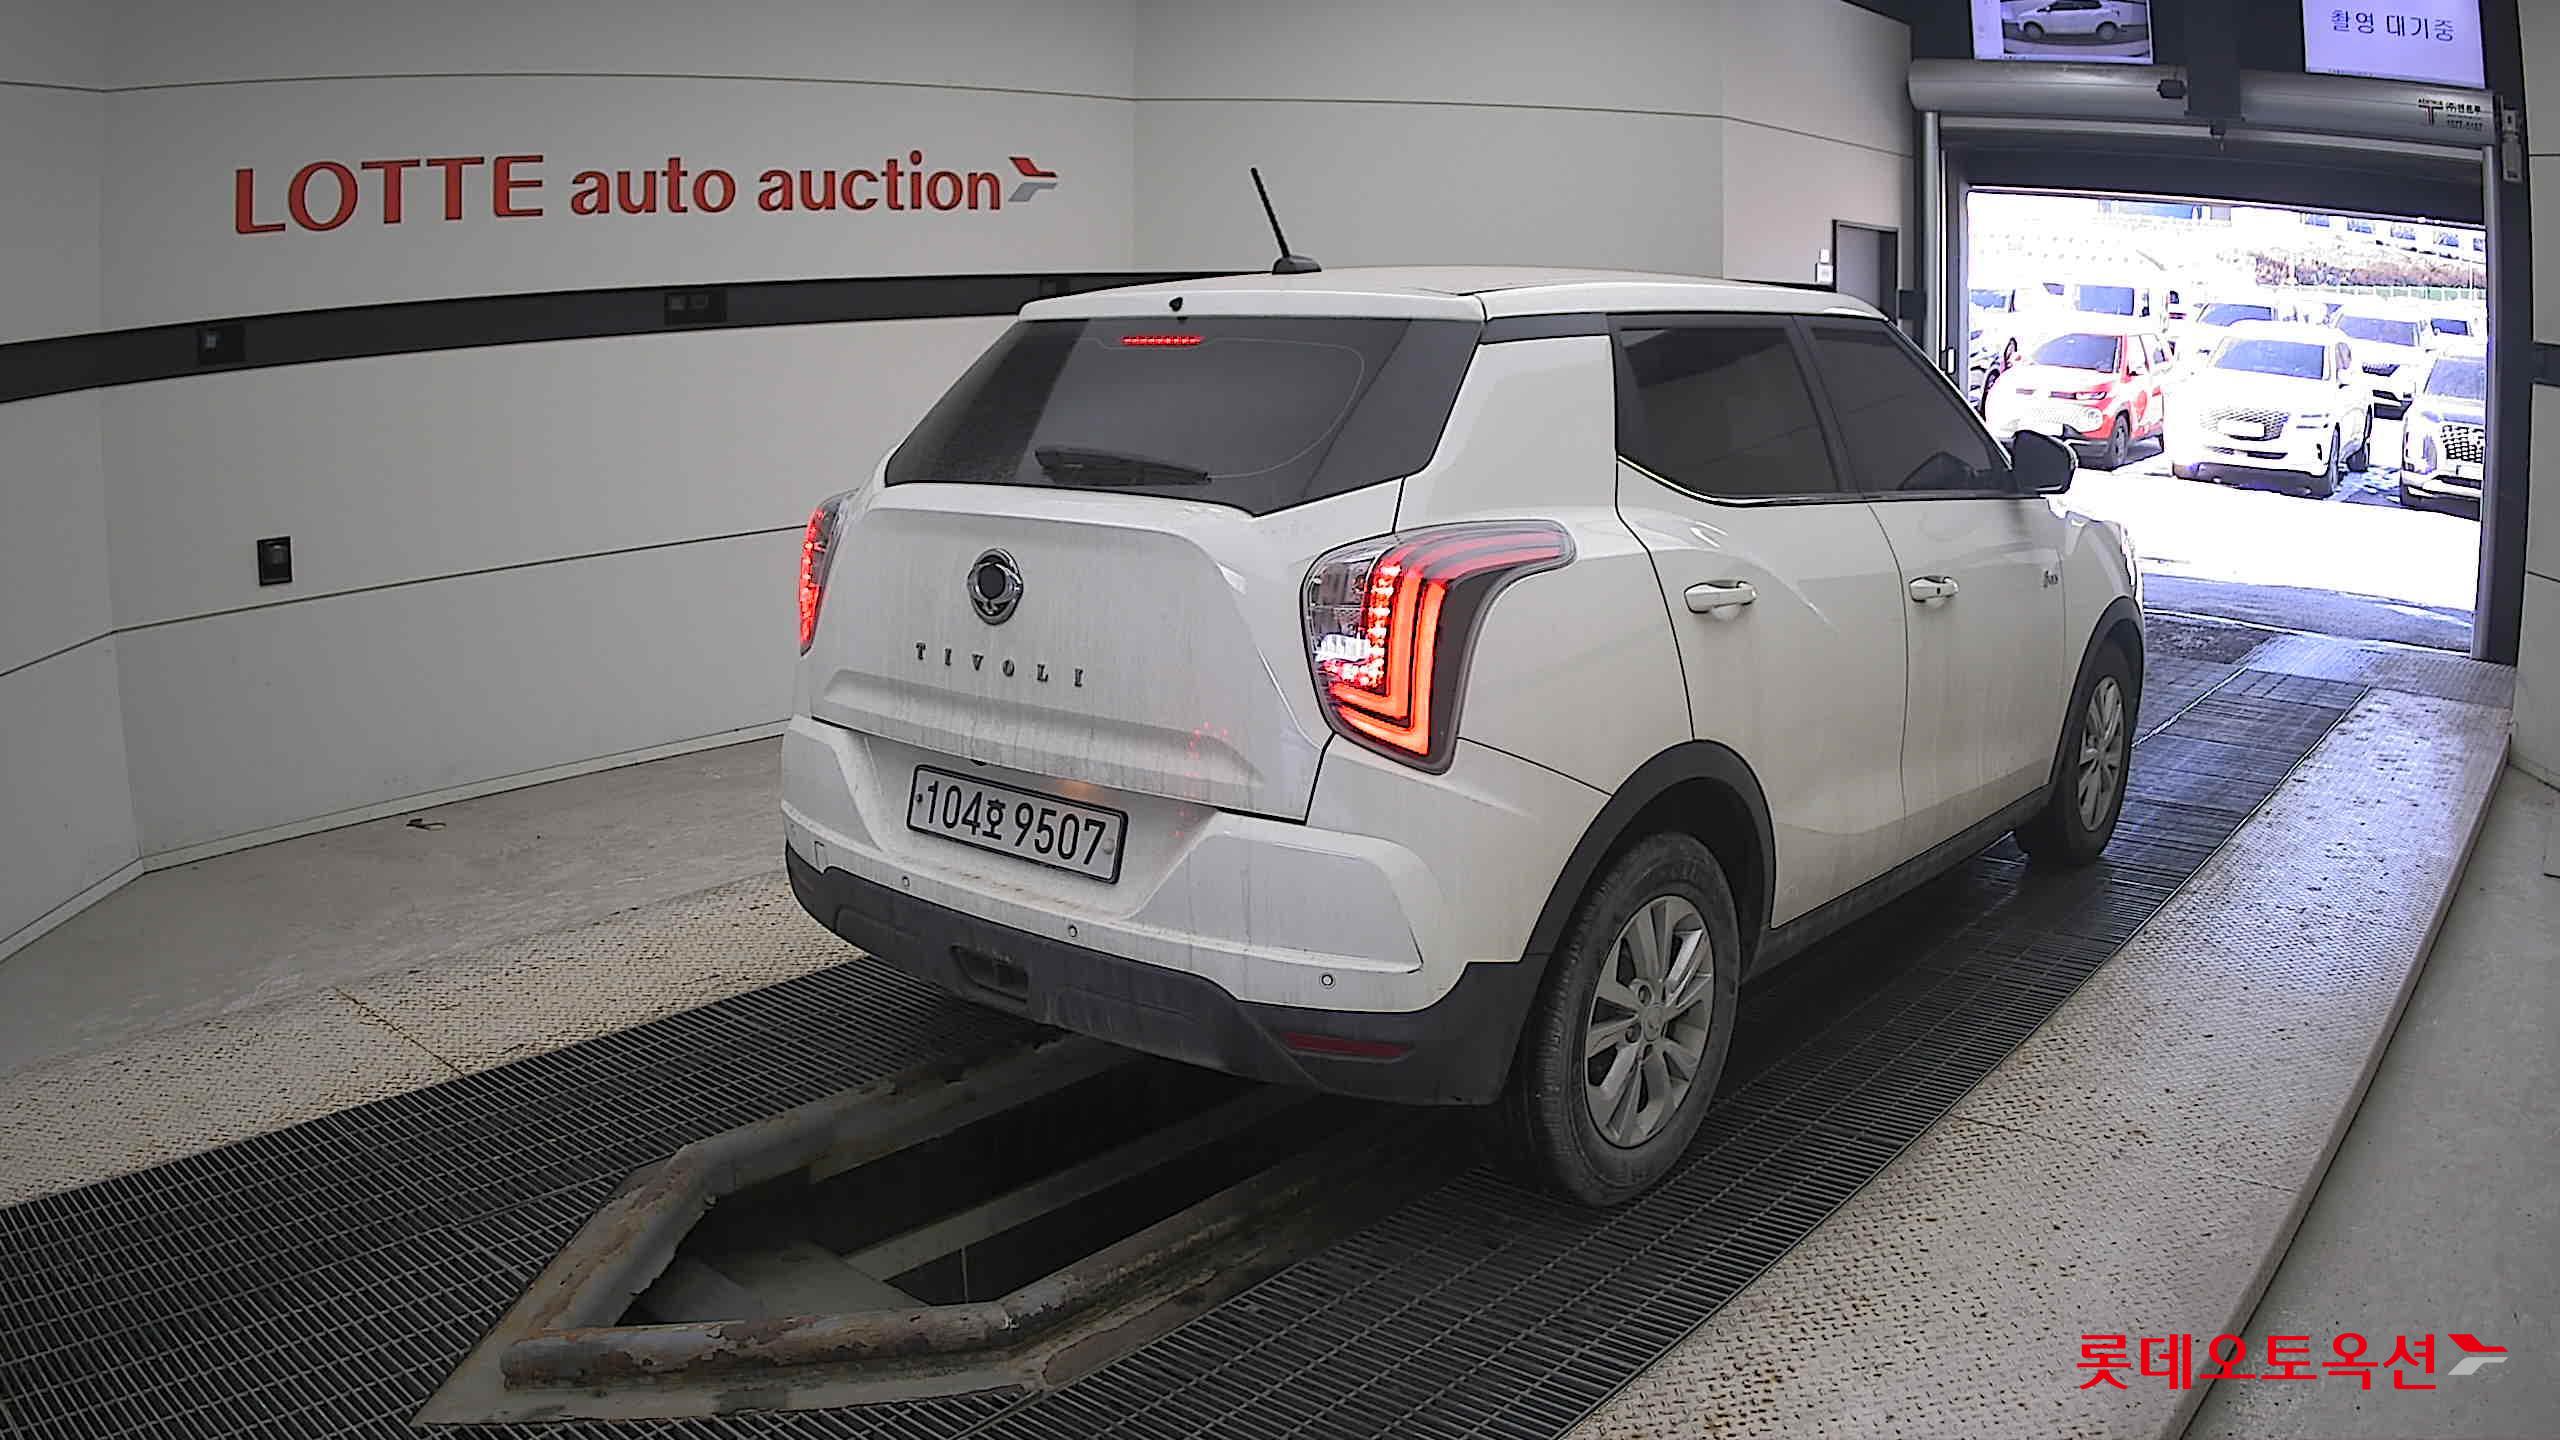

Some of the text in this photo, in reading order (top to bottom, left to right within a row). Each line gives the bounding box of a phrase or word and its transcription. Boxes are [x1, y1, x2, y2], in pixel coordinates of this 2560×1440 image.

[2332, 9, 2454, 42] 촬영 대기중
[234, 149, 1002, 234] LOTTE auto auction
[915, 641, 1084, 688] TIVOLI
[927, 780, 1107, 866] 104호 9507
